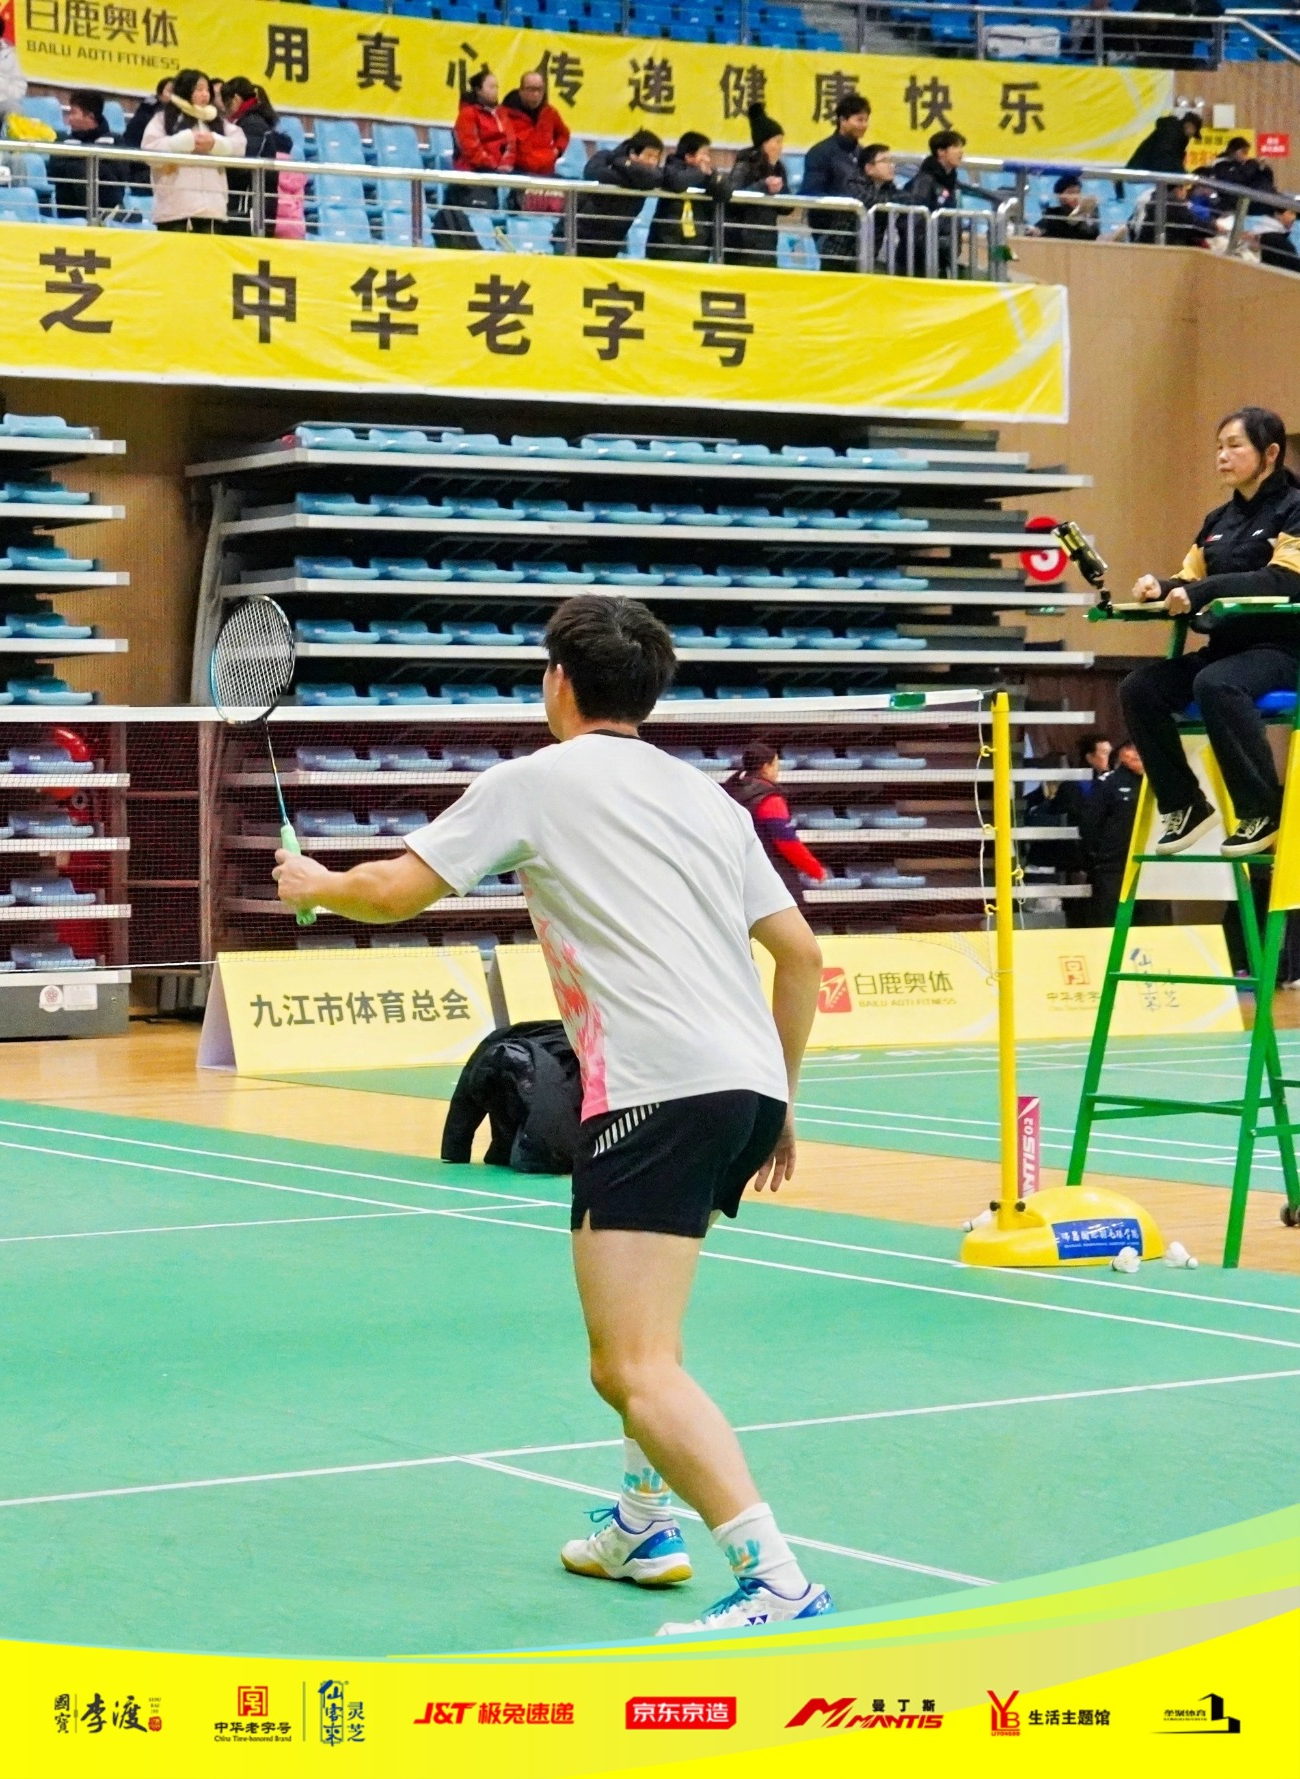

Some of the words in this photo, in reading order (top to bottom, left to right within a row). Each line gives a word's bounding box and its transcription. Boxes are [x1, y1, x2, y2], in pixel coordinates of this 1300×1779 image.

[26, 0, 178, 47] 白鹿奥体
[26, 39, 71, 57] BAILU
[117, 52, 180, 71] FITNESS
[264, 24, 1046, 134] 用真心传递健康快乐
[230, 259, 756, 368] 中华老字号
[854, 970, 954, 995] 白鹿奥体
[249, 988, 472, 1029] 九江市体育总会
